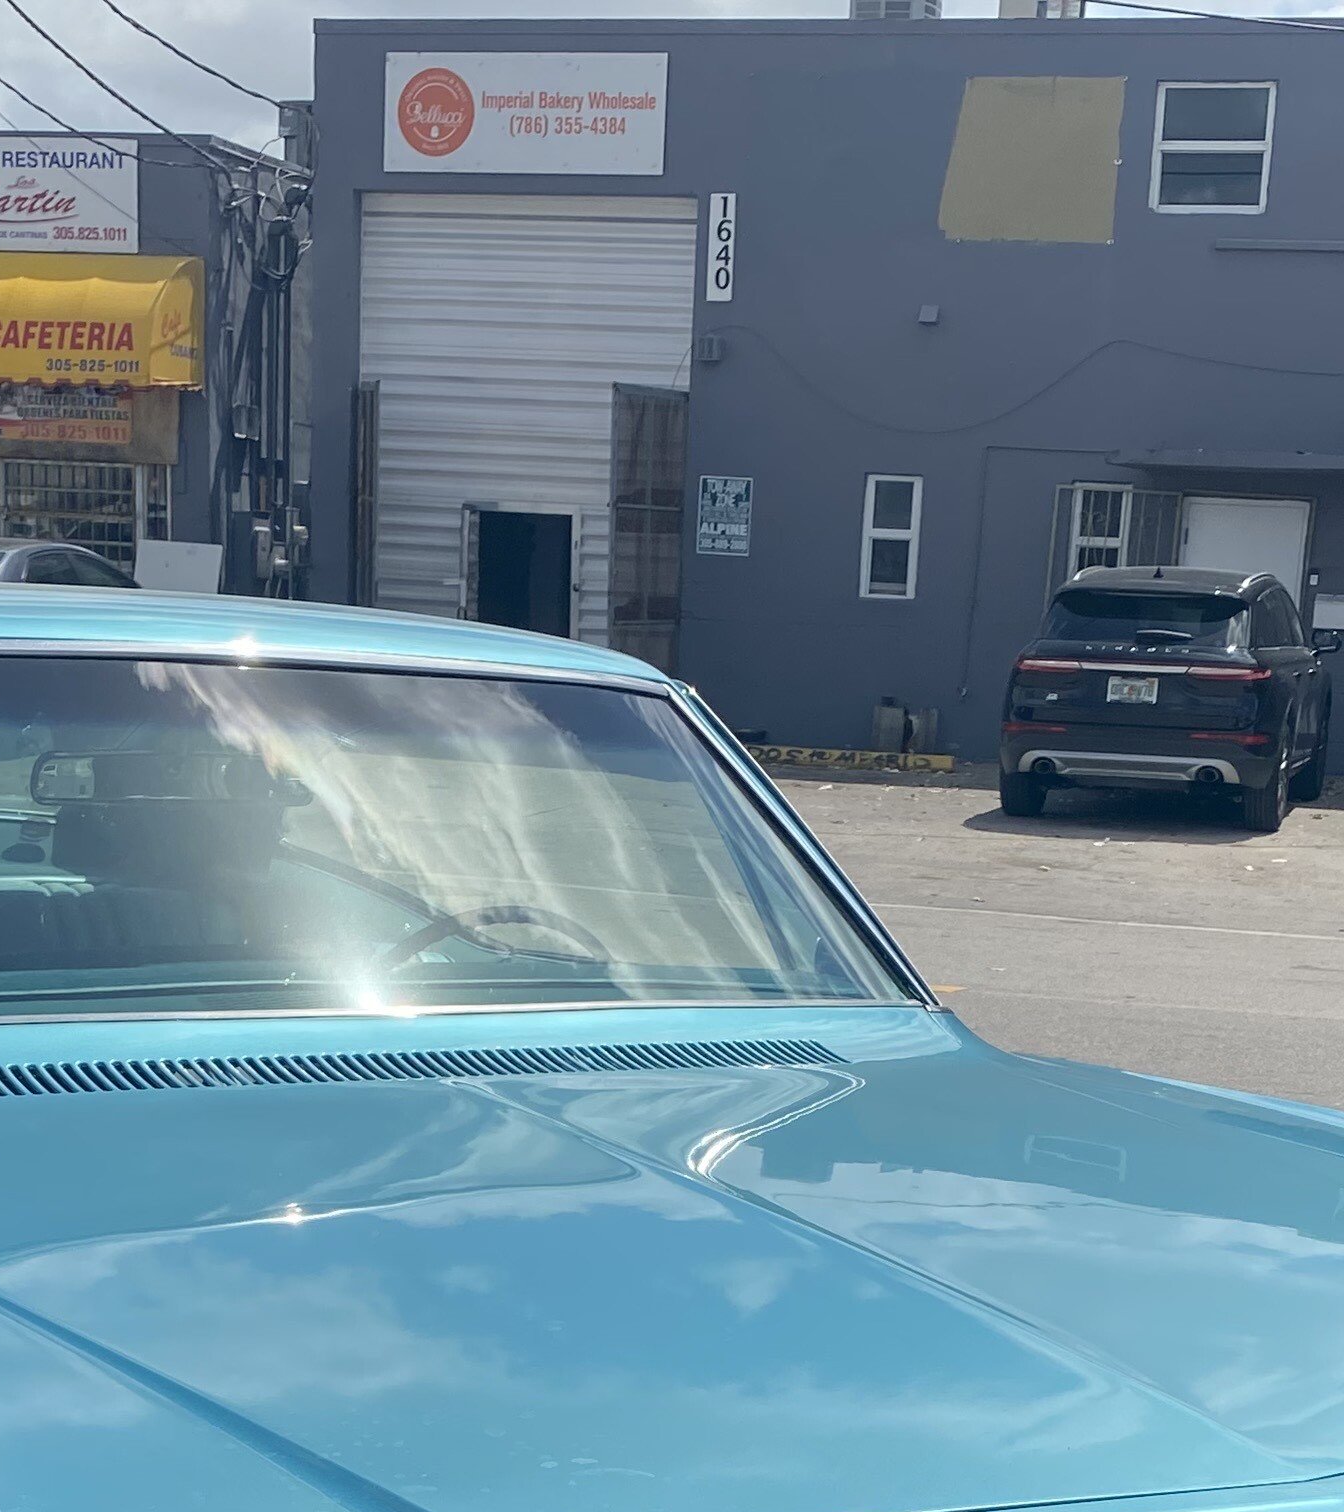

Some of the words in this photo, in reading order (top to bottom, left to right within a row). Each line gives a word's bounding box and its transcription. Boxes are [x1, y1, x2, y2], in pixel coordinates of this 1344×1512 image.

[481, 91, 534, 112] Imperial
[538, 92, 584, 113] Bakery
[588, 92, 656, 110] Wholesale
[509, 115, 548, 138] (786)
[554, 117, 626, 135] 355-4384
[2, 151, 124, 169] RESTAURANT
[52, 226, 128, 242] 305.825.1011
[716, 196, 732, 290] 1640
[45, 358, 140, 373] 305-825-1011
[701, 522, 748, 536] ALPINE
